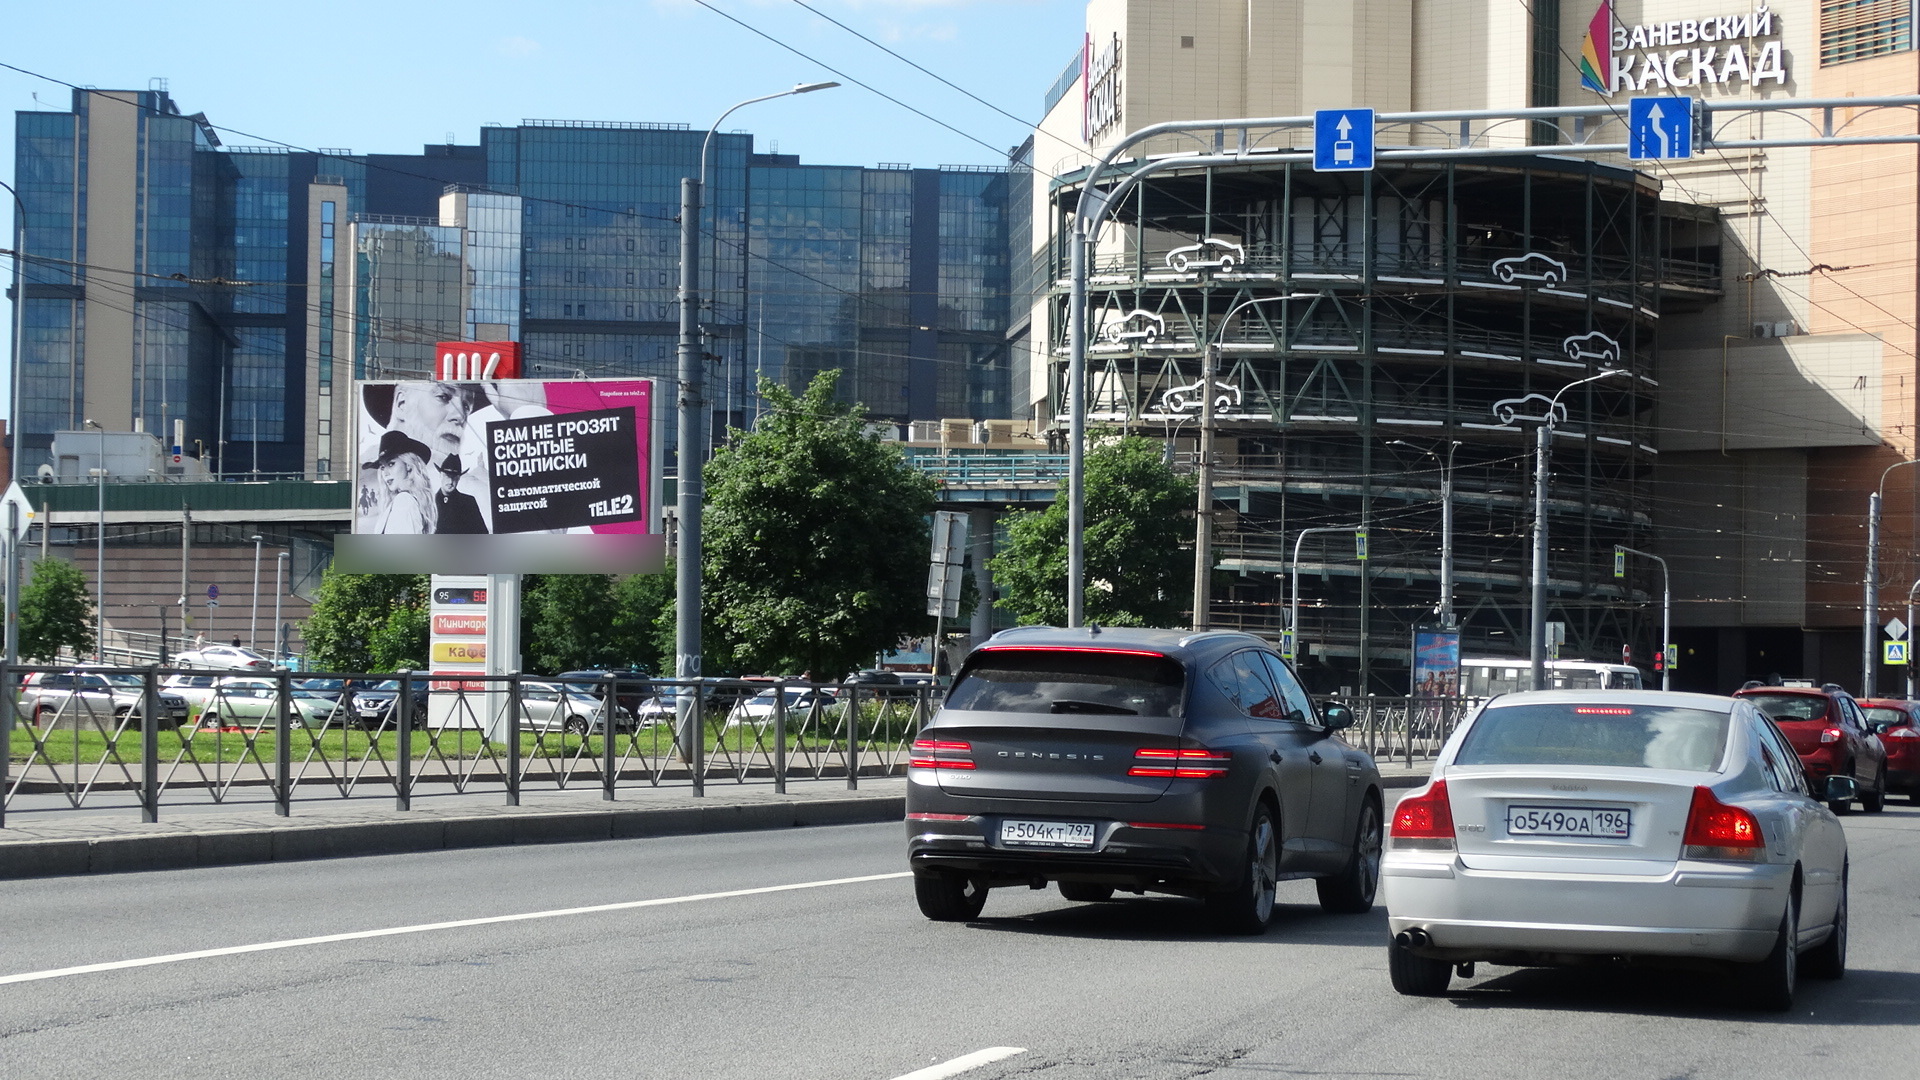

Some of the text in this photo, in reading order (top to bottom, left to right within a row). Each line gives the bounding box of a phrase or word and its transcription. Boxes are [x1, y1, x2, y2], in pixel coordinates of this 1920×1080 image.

[1613, 5, 1771, 51] ЗАНЕВСКИЙ
[1612, 41, 1786, 92] КАСКАД
[493, 416, 620, 444] ВАМ НЕ ГРОЗЯТ
[494, 438, 575, 460] СКРЫТЫЕ
[495, 453, 588, 477] ПОДПИСКИ
[497, 478, 601, 498] С автоматической
[498, 498, 548, 513] защитой
[588, 494, 634, 517] TELE2
[439, 591, 449, 600] 95
[998, 751, 1104, 760] GENESIS
[1007, 823, 1090, 839] Р504КТ 797
[1595, 813, 1624, 828] 196
